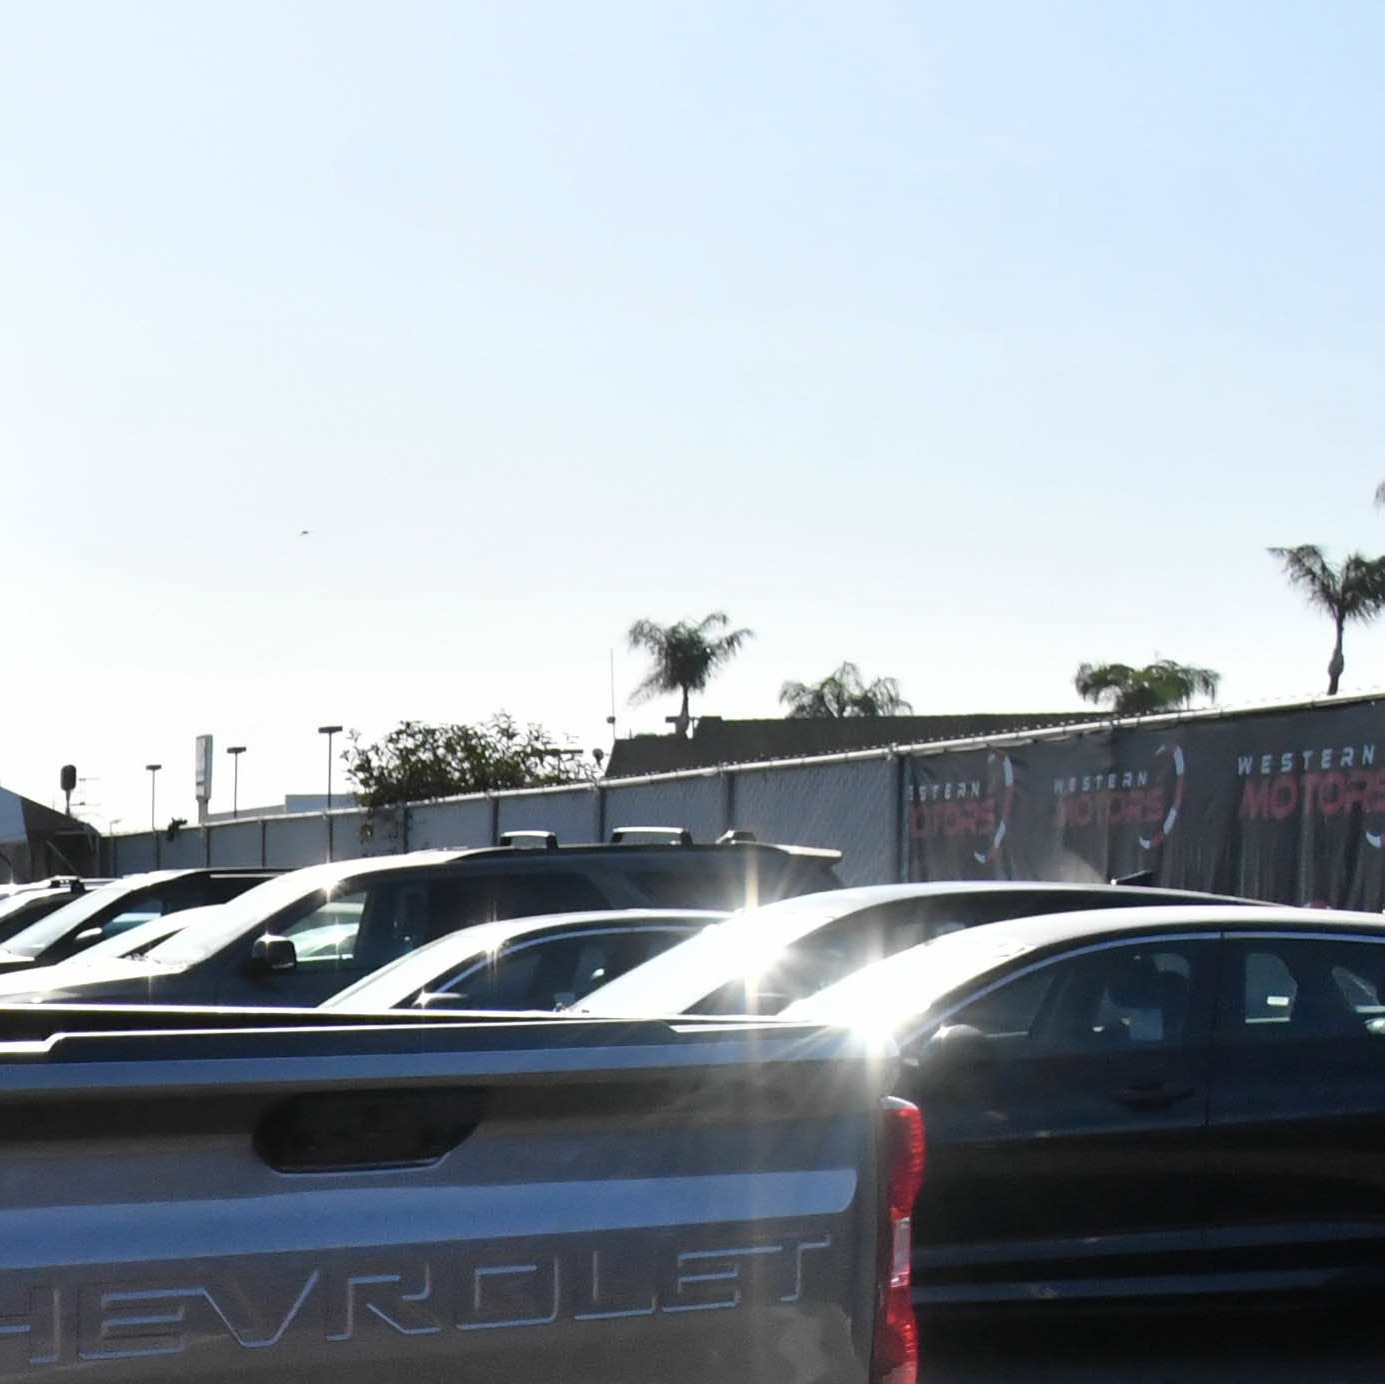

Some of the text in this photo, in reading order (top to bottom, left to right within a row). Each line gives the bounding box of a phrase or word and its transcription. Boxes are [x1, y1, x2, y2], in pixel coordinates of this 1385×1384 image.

[1237, 744, 1376, 775] WESTERN
[1054, 770, 1149, 794] WESTERN
[1058, 789, 1164, 827] MOTORS
